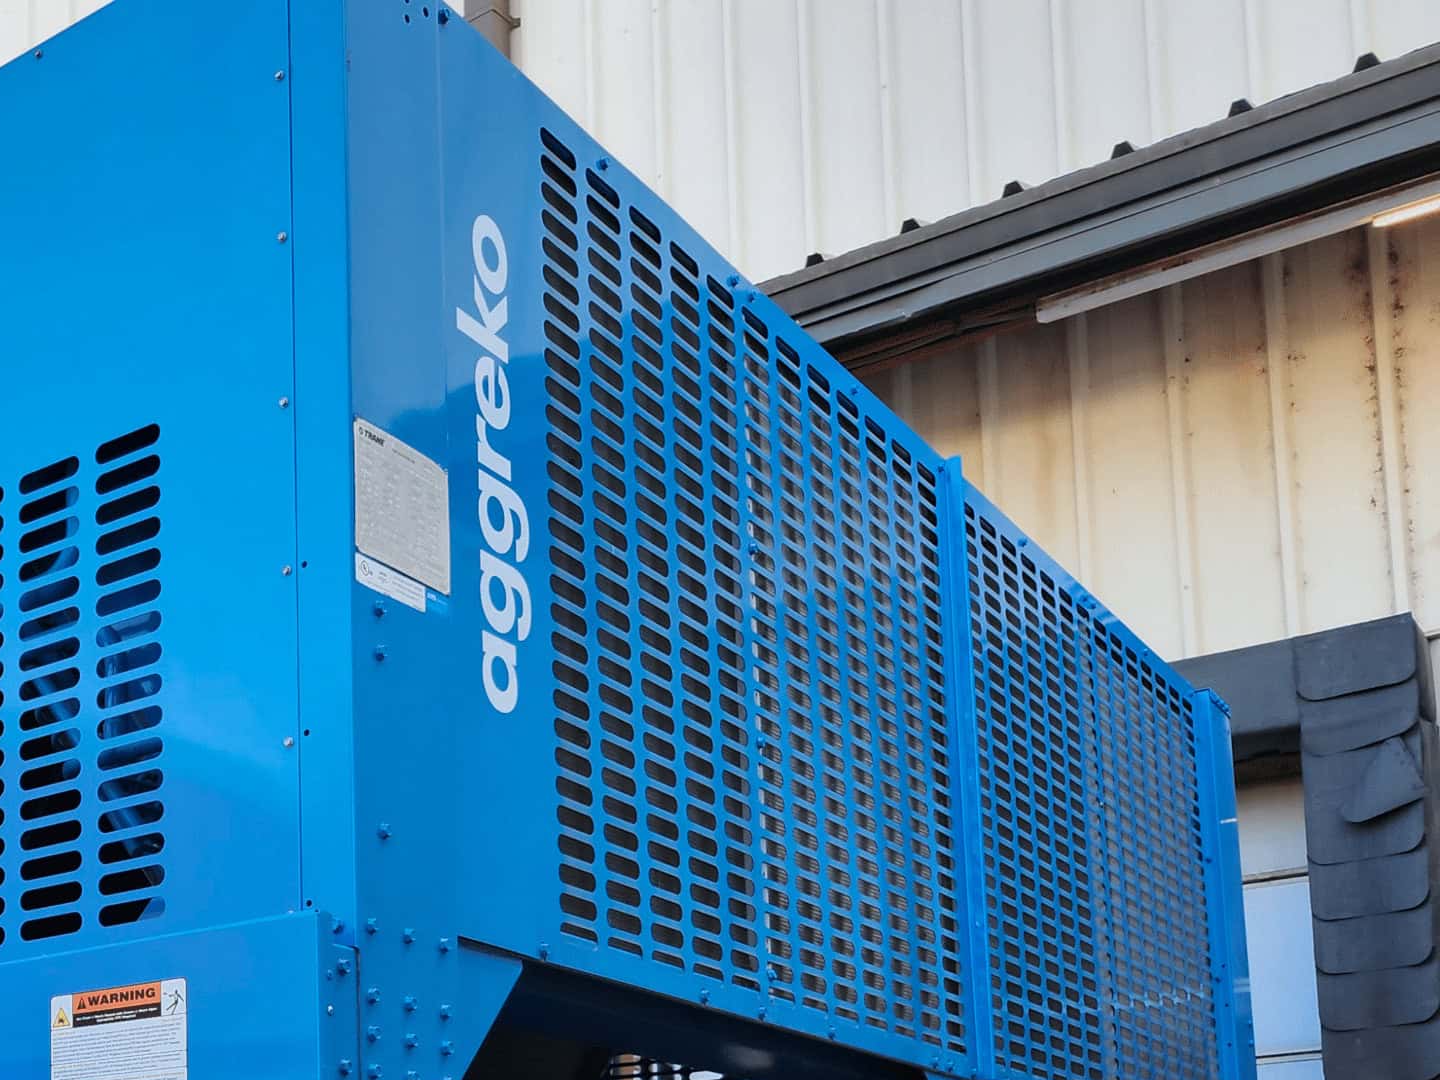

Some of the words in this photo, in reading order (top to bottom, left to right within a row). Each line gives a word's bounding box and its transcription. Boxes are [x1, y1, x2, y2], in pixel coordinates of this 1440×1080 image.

[364, 429, 386, 447] TRANE
[456, 213, 532, 714] aggreko
[87, 987, 156, 1006] WARNING
